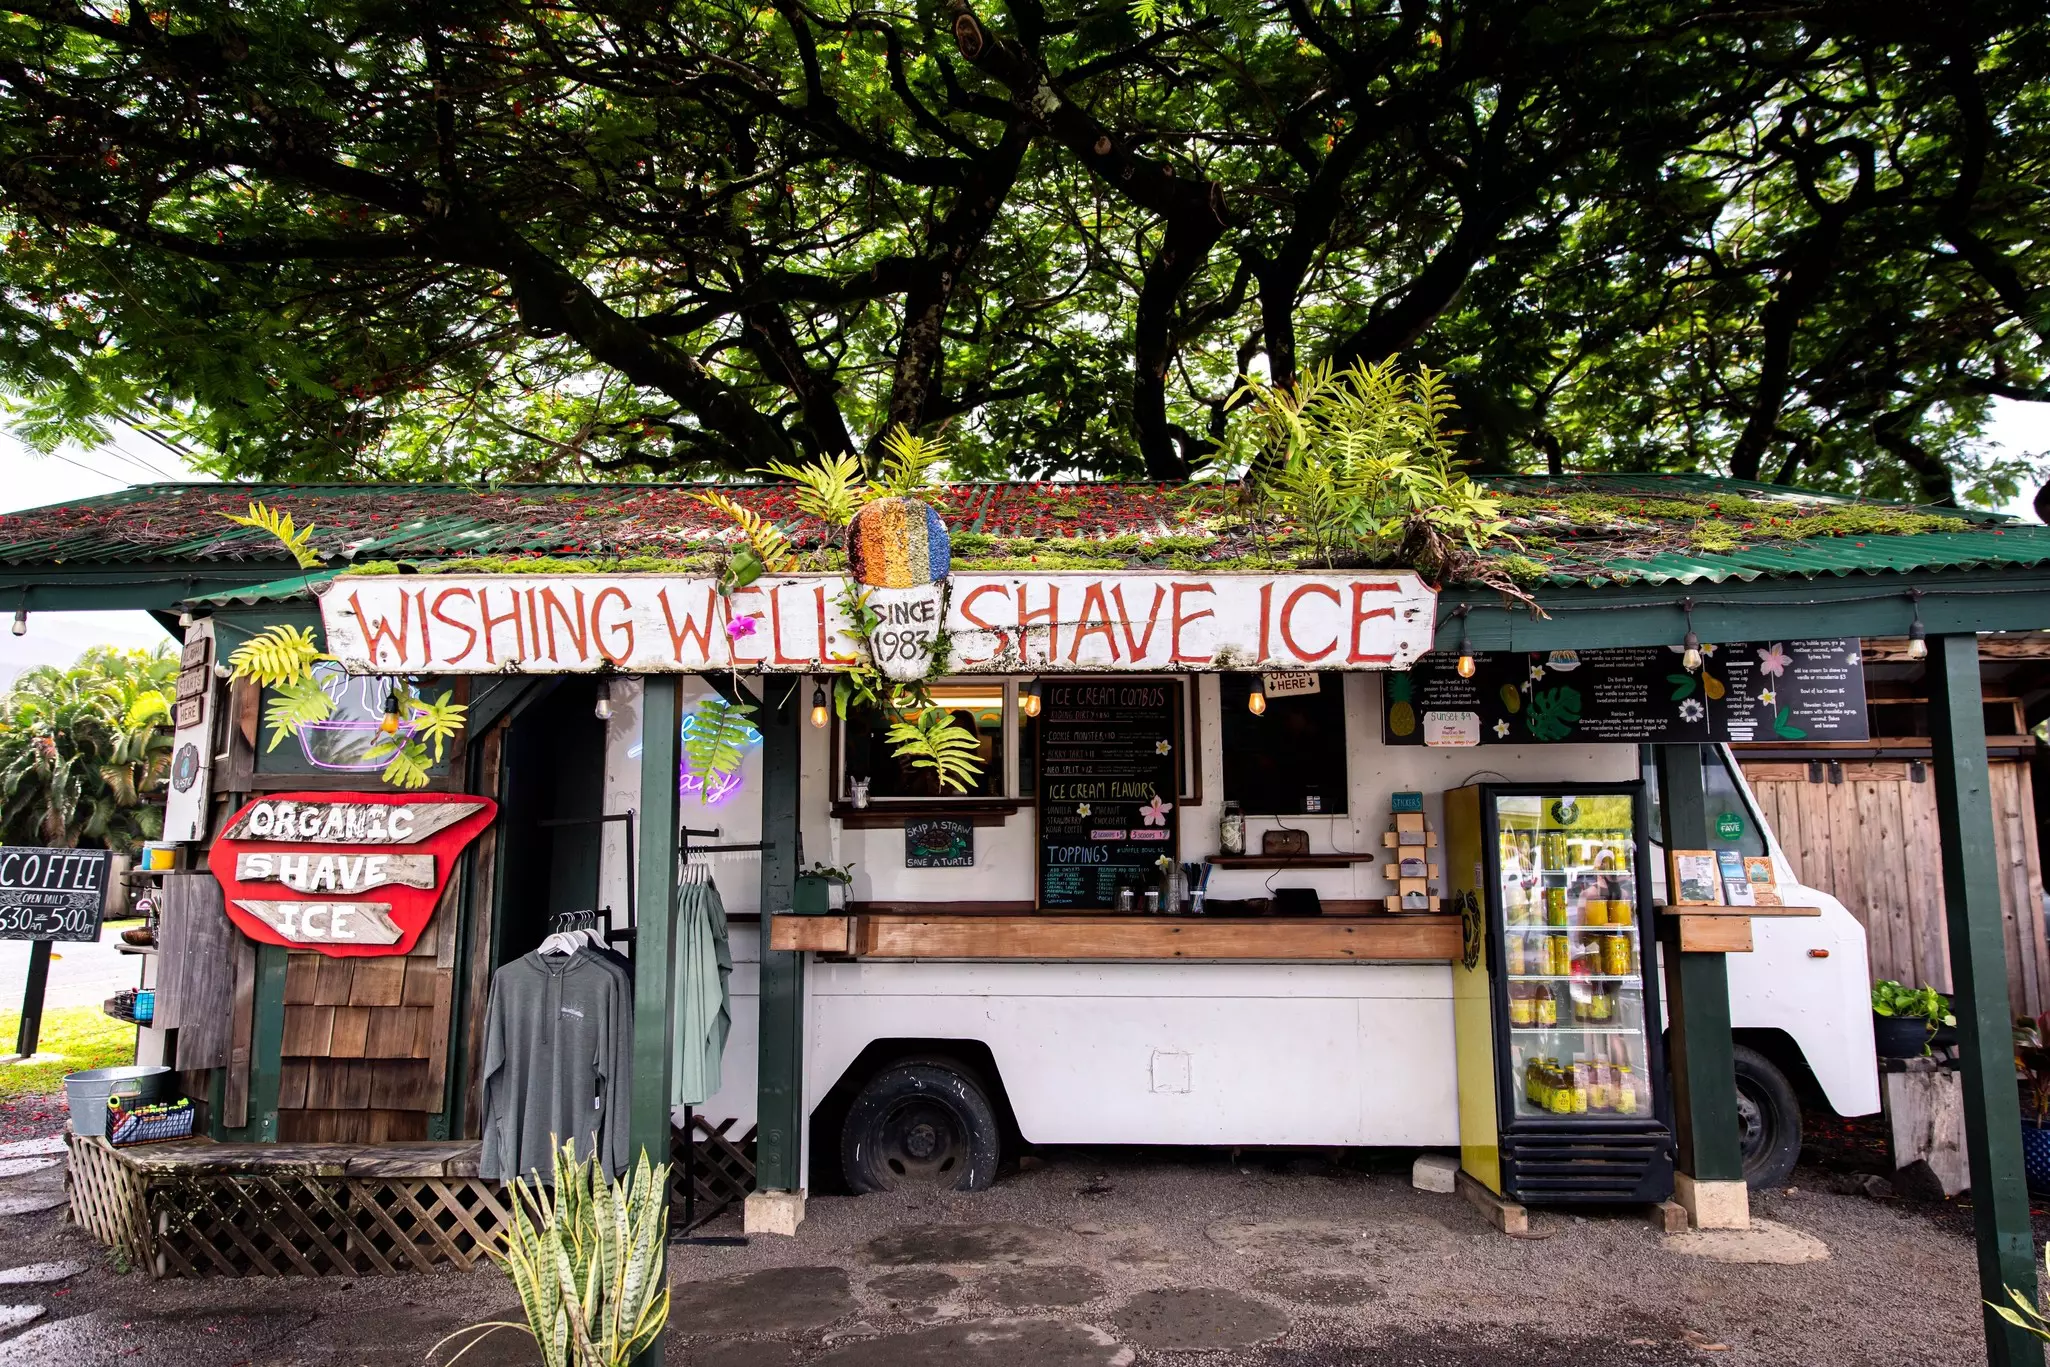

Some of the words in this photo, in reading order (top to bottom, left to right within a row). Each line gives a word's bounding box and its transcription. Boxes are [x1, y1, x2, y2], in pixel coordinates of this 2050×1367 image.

[870, 599, 935, 626] SINCE
[348, 586, 634, 667] WISHING
[657, 584, 857, 667] WELL
[960, 580, 1217, 665] SHAVE
[1257, 580, 1402, 664] ICE
[874, 630, 930, 662] 1983
[179, 675, 201, 691] STARTS
[1277, 679, 1306, 690] HERE
[1051, 687, 1072, 706] ICE
[1077, 687, 1116, 706] CREAM
[1120, 687, 1165, 706] COMBOS
[180, 705, 196, 721] HERE
[1431, 712, 1458, 721] Sunset
[1461, 712, 1471, 721] $9
[1048, 731, 1071, 740] COOKIE
[1073, 731, 1104, 740] MONSTER
[181, 745, 191, 759] NO
[1047, 765, 1060, 774] NEO
[1062, 765, 1079, 774] SPLIT
[175, 777, 192, 788] PLASTIC
[1049, 784, 1066, 799] ICE
[1069, 781, 1105, 799] CREAM
[1111, 781, 1156, 799] FLAVORS
[1047, 806, 1072, 815] VANILLA
[1392, 798, 1421, 808] STICKERS
[250, 803, 414, 839] ORGANIC
[1046, 817, 1083, 825] STRAWBERRY
[1094, 817, 1127, 825] CHOCOLATE
[907, 824, 928, 837] SKIP
[941, 822, 972, 834] STRAW
[941, 857, 973, 865] TURTLE
[1047, 845, 1109, 863] TOPPINGS
[1, 854, 104, 889] COFFEE
[244, 854, 388, 890] SHAVE
[22, 894, 42, 903] OPEN
[44, 894, 65, 904] DAILY
[46, 907, 87, 933] 5:00
[277, 904, 356, 939] ICE
